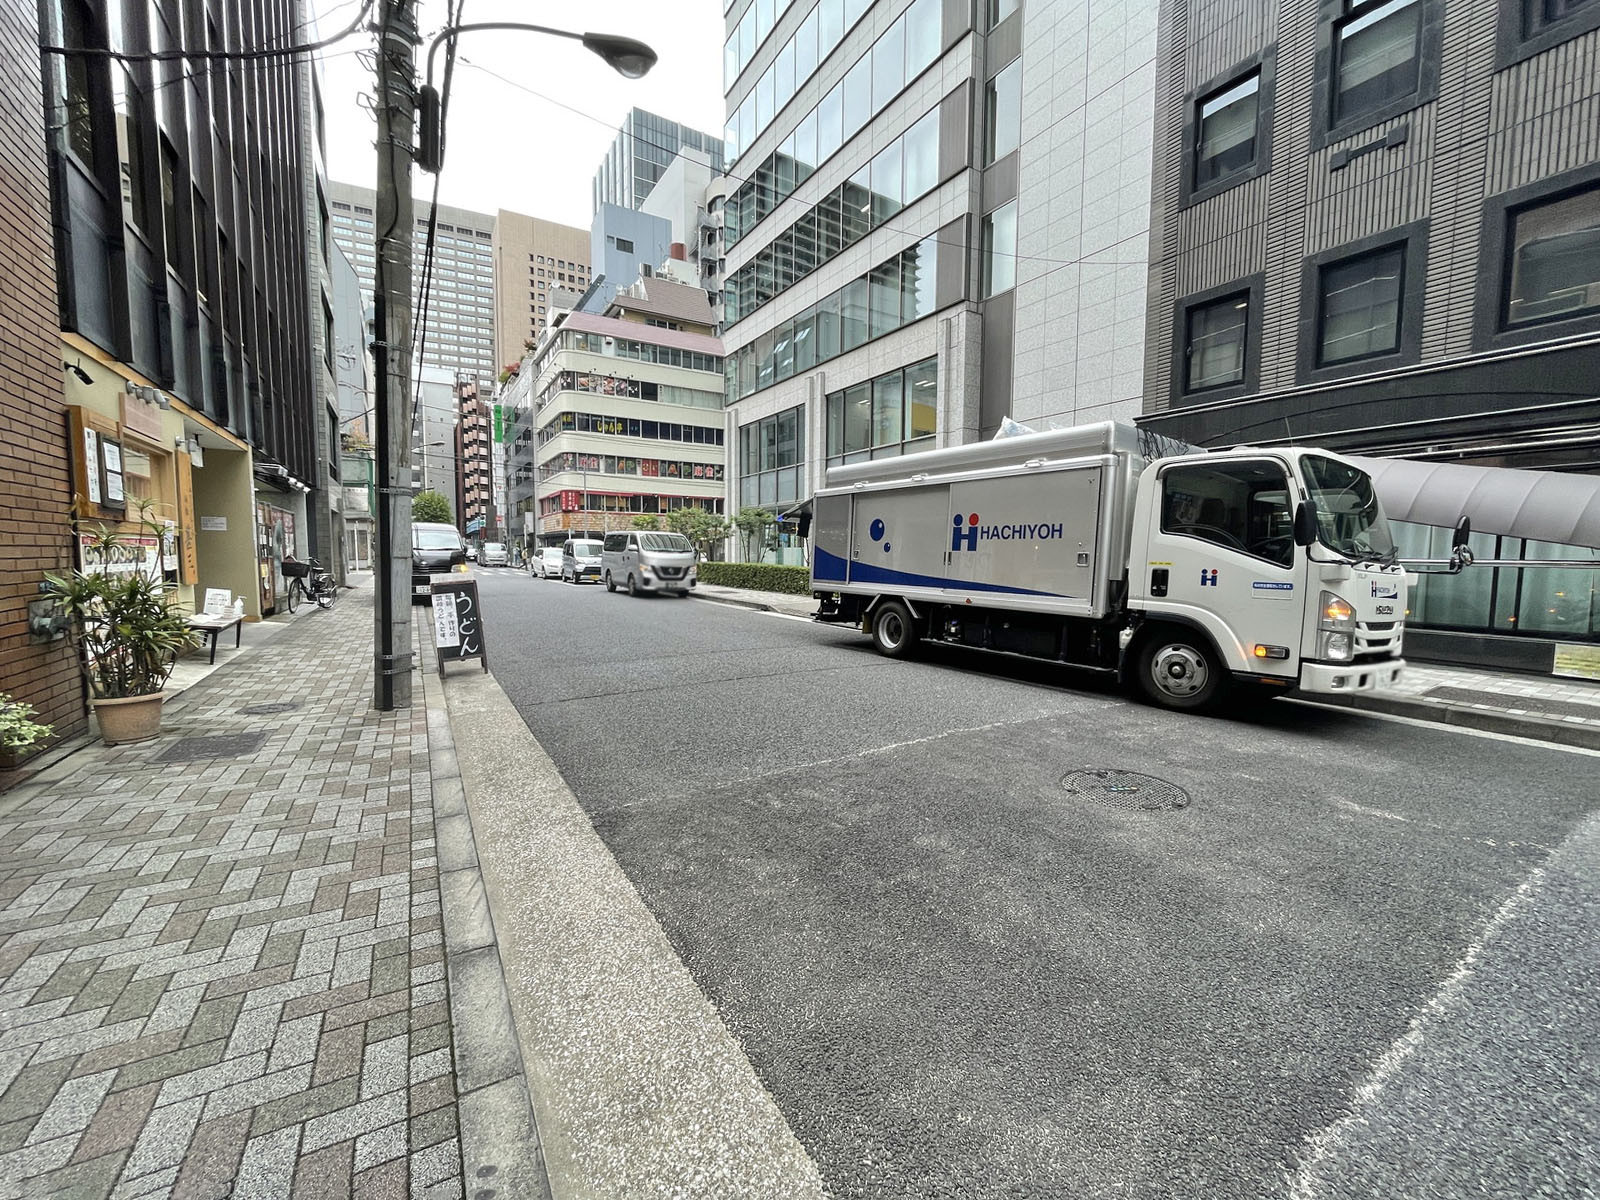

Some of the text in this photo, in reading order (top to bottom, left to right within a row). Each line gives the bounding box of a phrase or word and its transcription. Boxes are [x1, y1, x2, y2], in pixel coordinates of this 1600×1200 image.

[980, 523, 1063, 540] HACHIYOH
[456, 591, 479, 656] うどん
